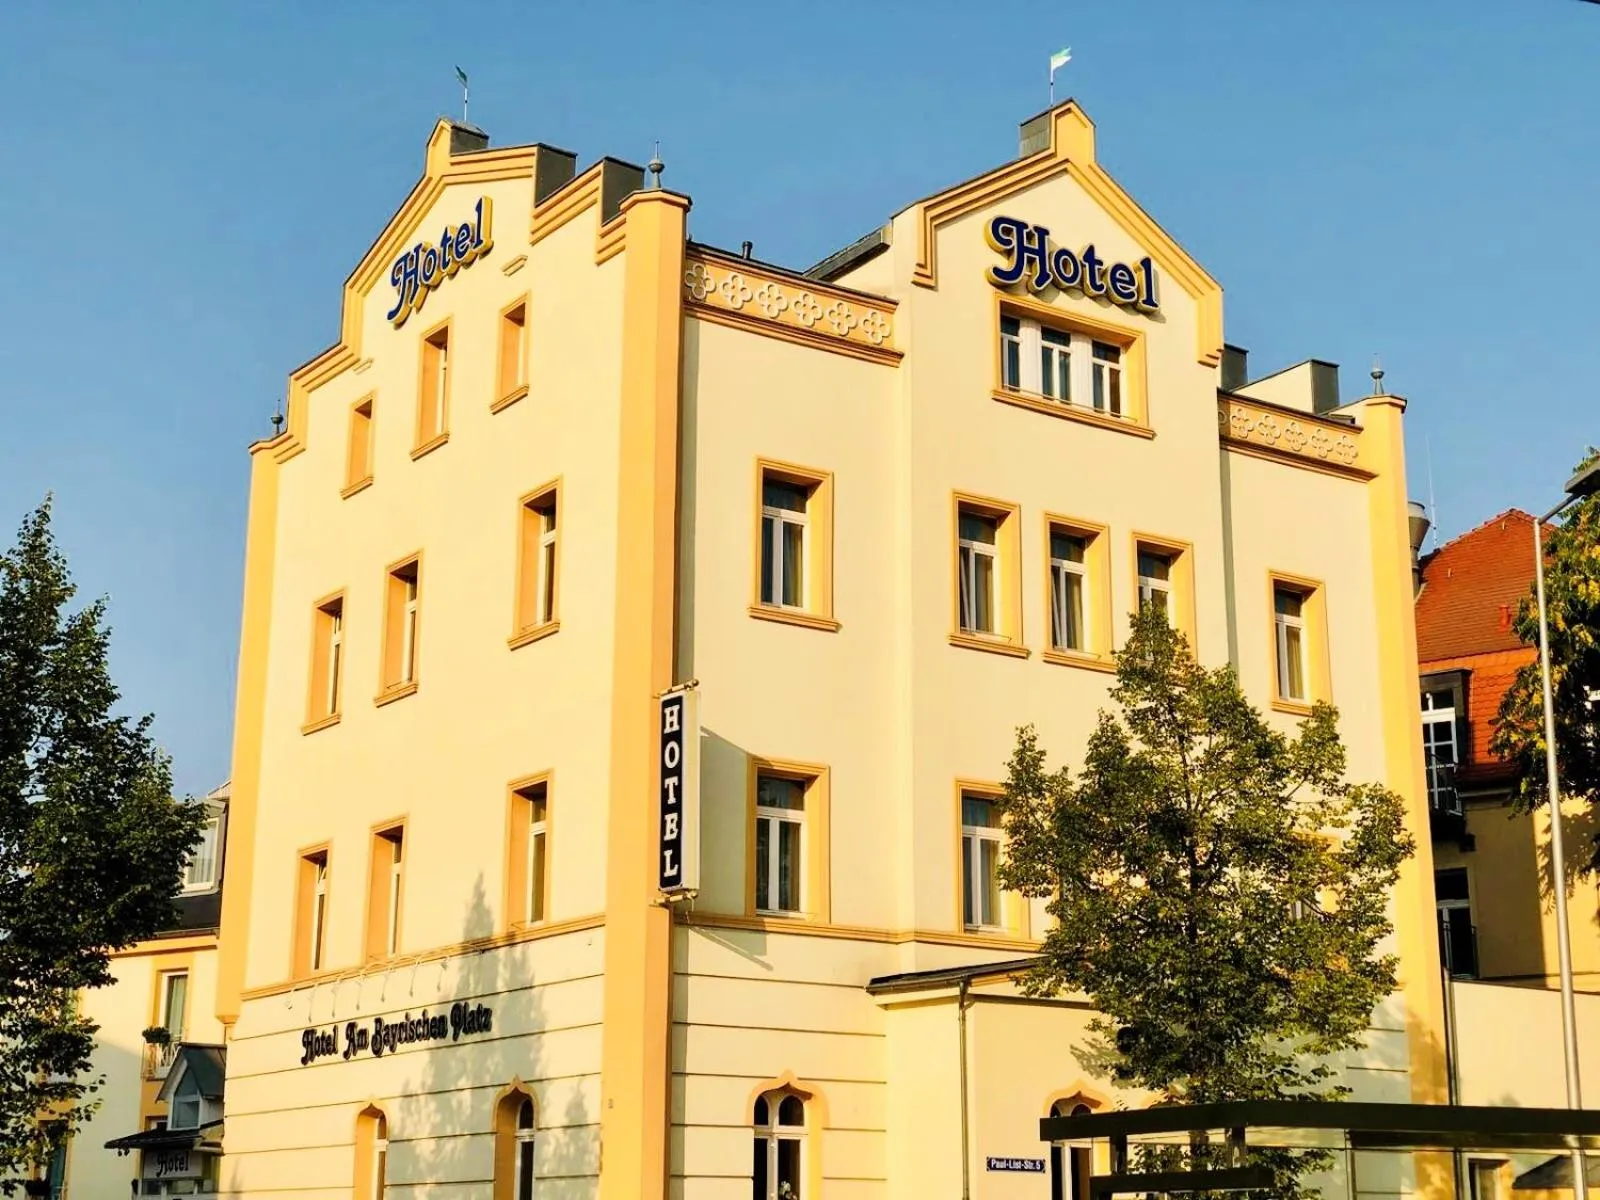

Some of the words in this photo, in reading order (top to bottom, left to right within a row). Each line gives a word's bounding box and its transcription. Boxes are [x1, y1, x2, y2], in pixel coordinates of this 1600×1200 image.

[386, 197, 487, 322] Hotel
[988, 215, 1160, 312] Hotel
[663, 704, 681, 878] HOTEL
[301, 1024, 338, 1066] Hotel
[342, 1020, 370, 1061] Am
[371, 1008, 448, 1058] Bayrischen
[450, 1001, 493, 1042] Platz
[156, 1151, 190, 1177] Hotel
